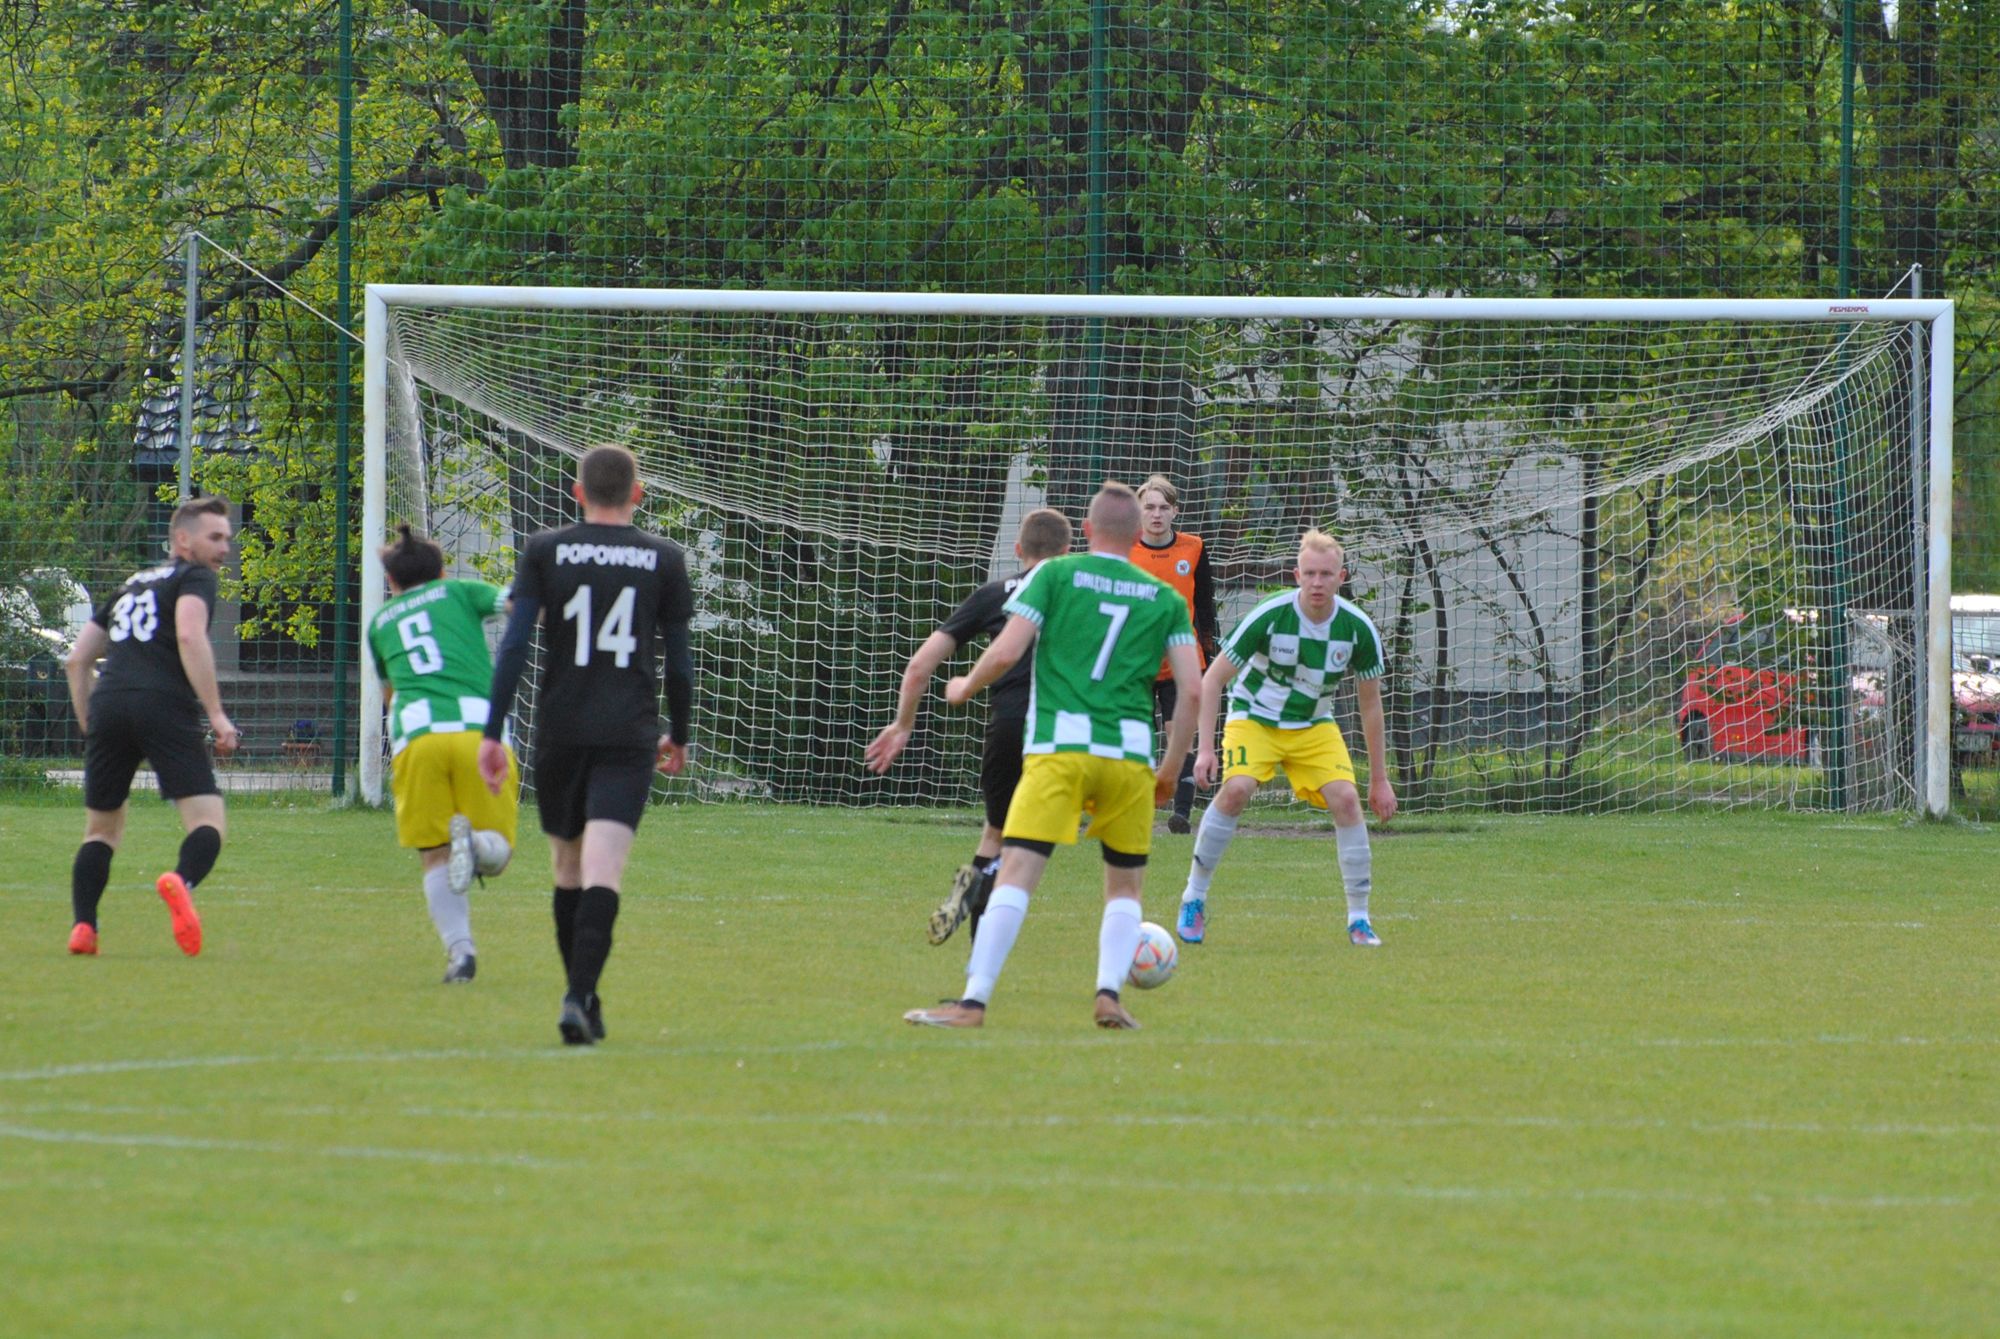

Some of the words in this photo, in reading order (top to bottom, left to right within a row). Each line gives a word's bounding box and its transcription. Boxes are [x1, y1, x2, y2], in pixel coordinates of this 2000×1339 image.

[555, 543, 657, 571] POPOWSKI
[109, 589, 158, 642] 30
[397, 609, 443, 675] 5
[562, 584, 637, 668] 14
[1090, 601, 1130, 681] 7
[1226, 745, 1249, 769] 11
